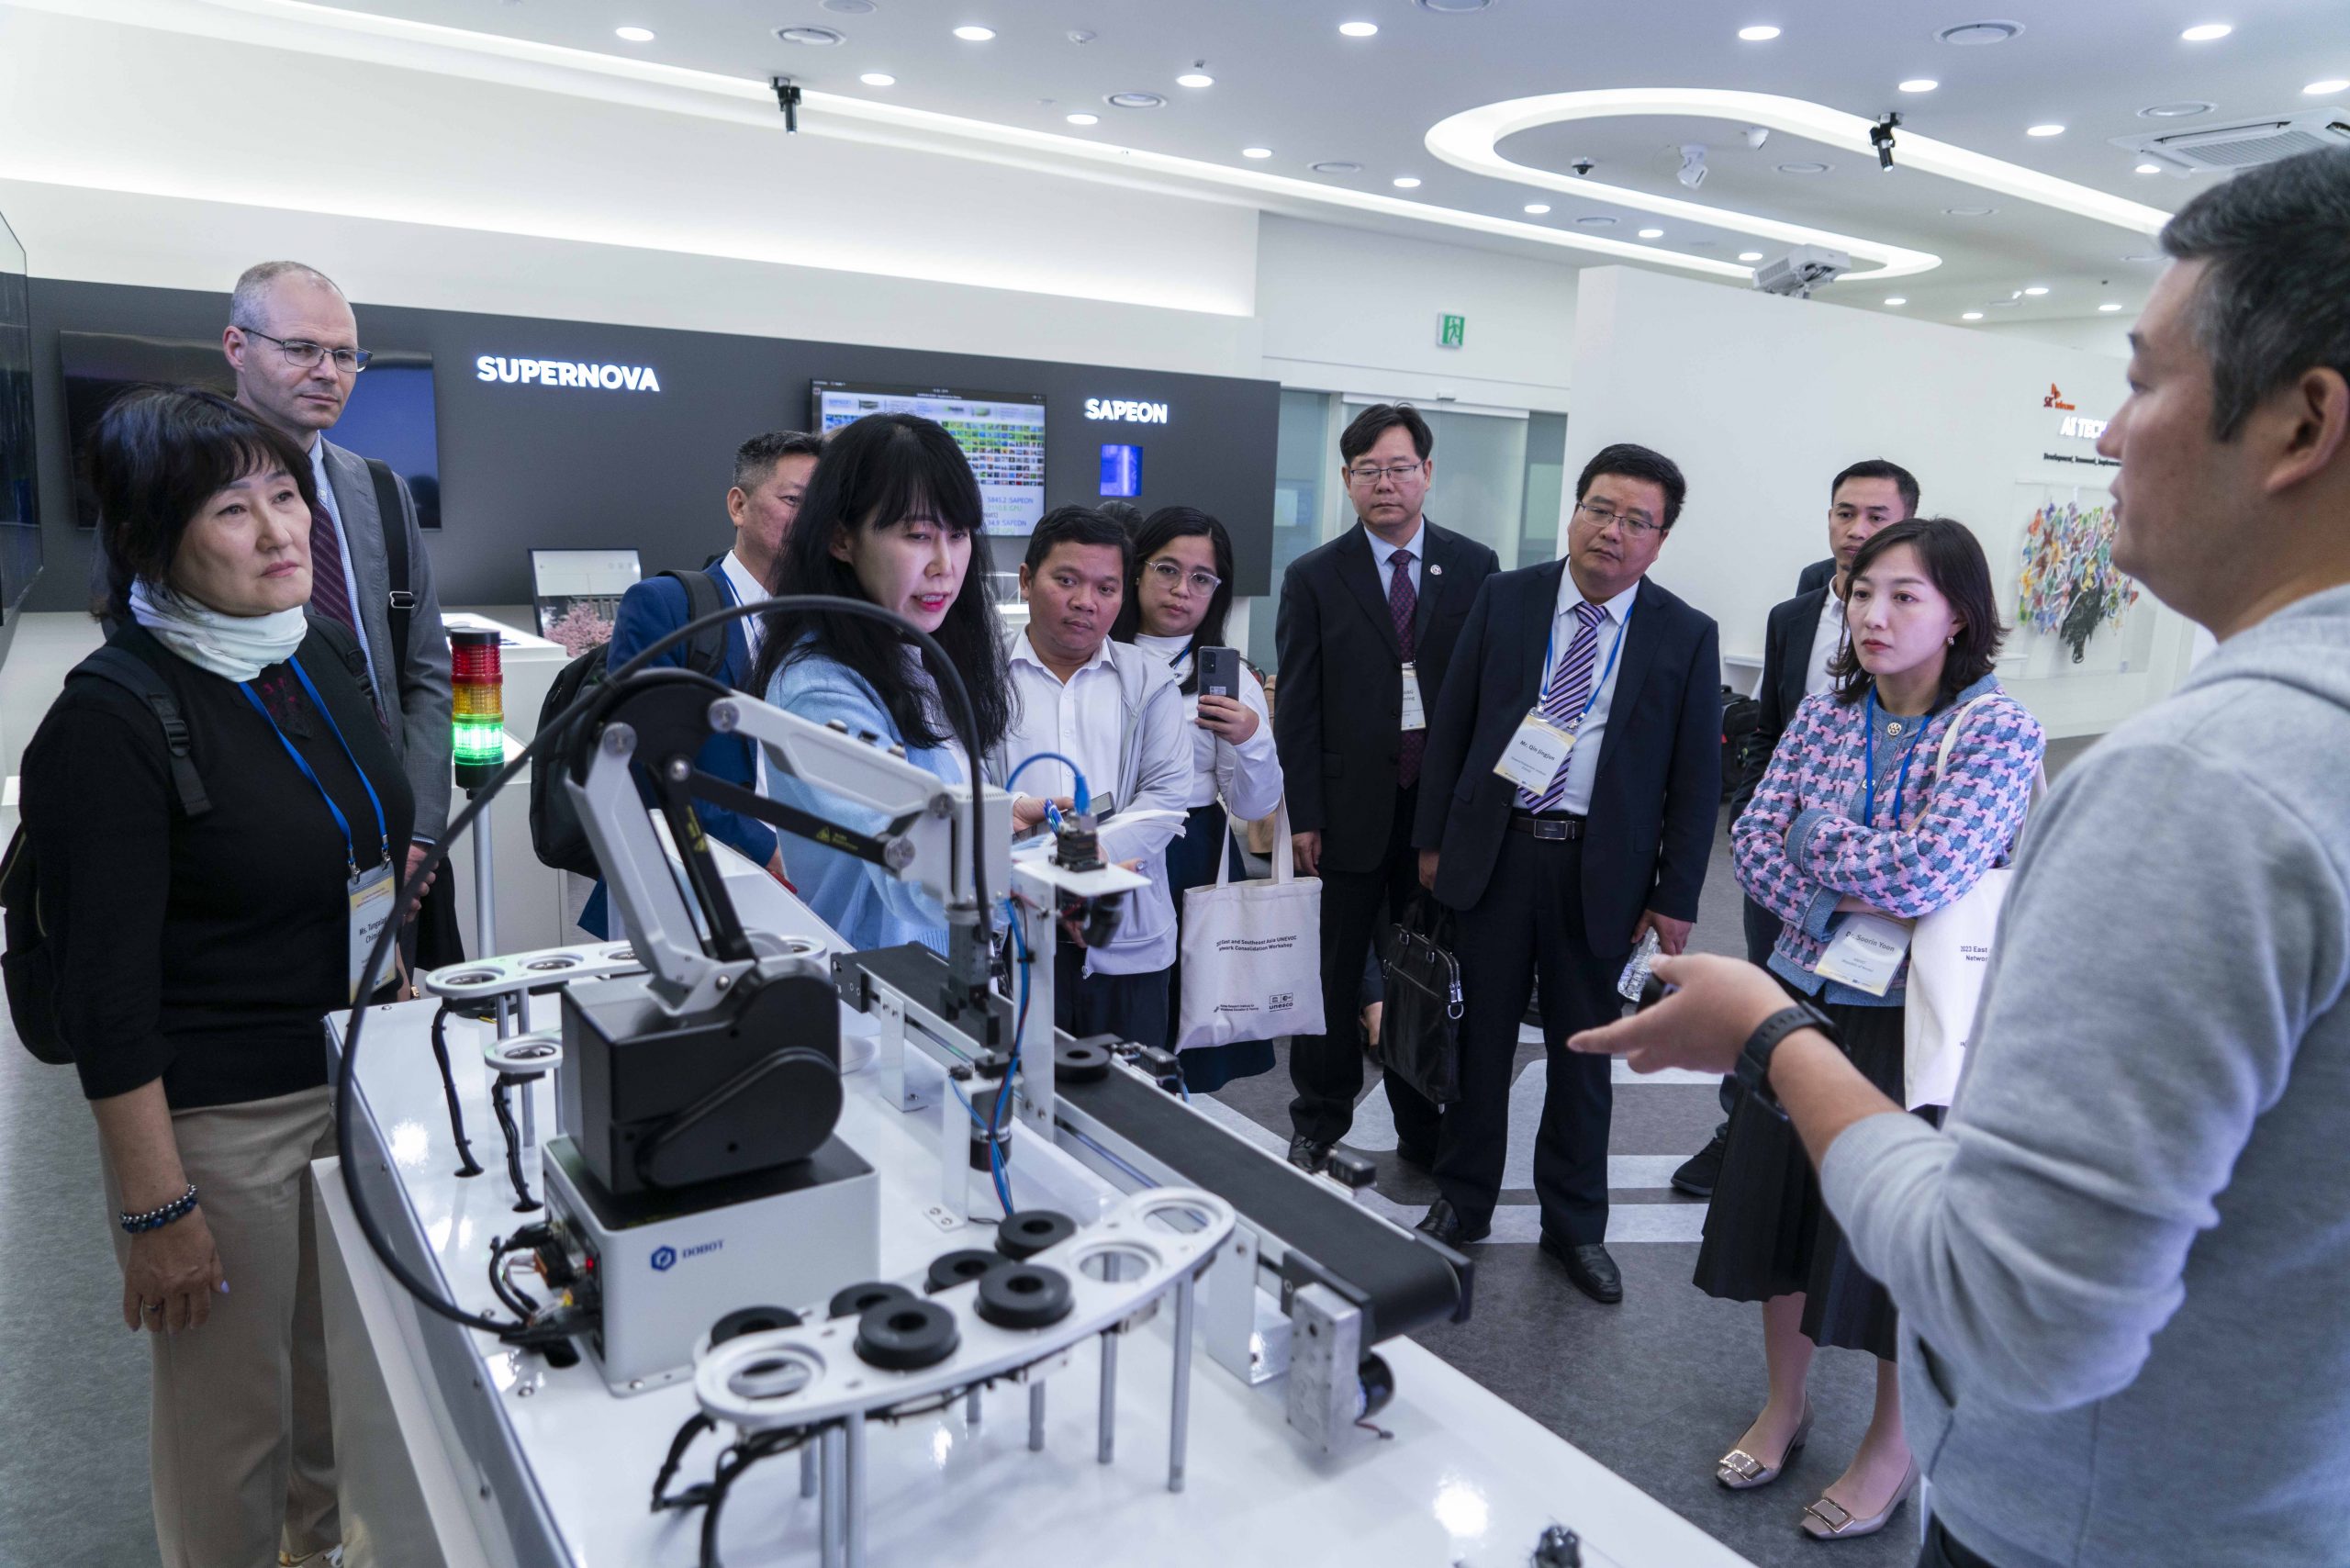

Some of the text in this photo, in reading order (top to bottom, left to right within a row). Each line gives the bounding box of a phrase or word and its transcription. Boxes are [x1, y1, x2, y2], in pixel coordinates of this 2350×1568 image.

[476, 355, 661, 392] SUPERNOVA
[1084, 398, 1169, 424] SAPEON
[1269, 1002, 1293, 1010] unesco
